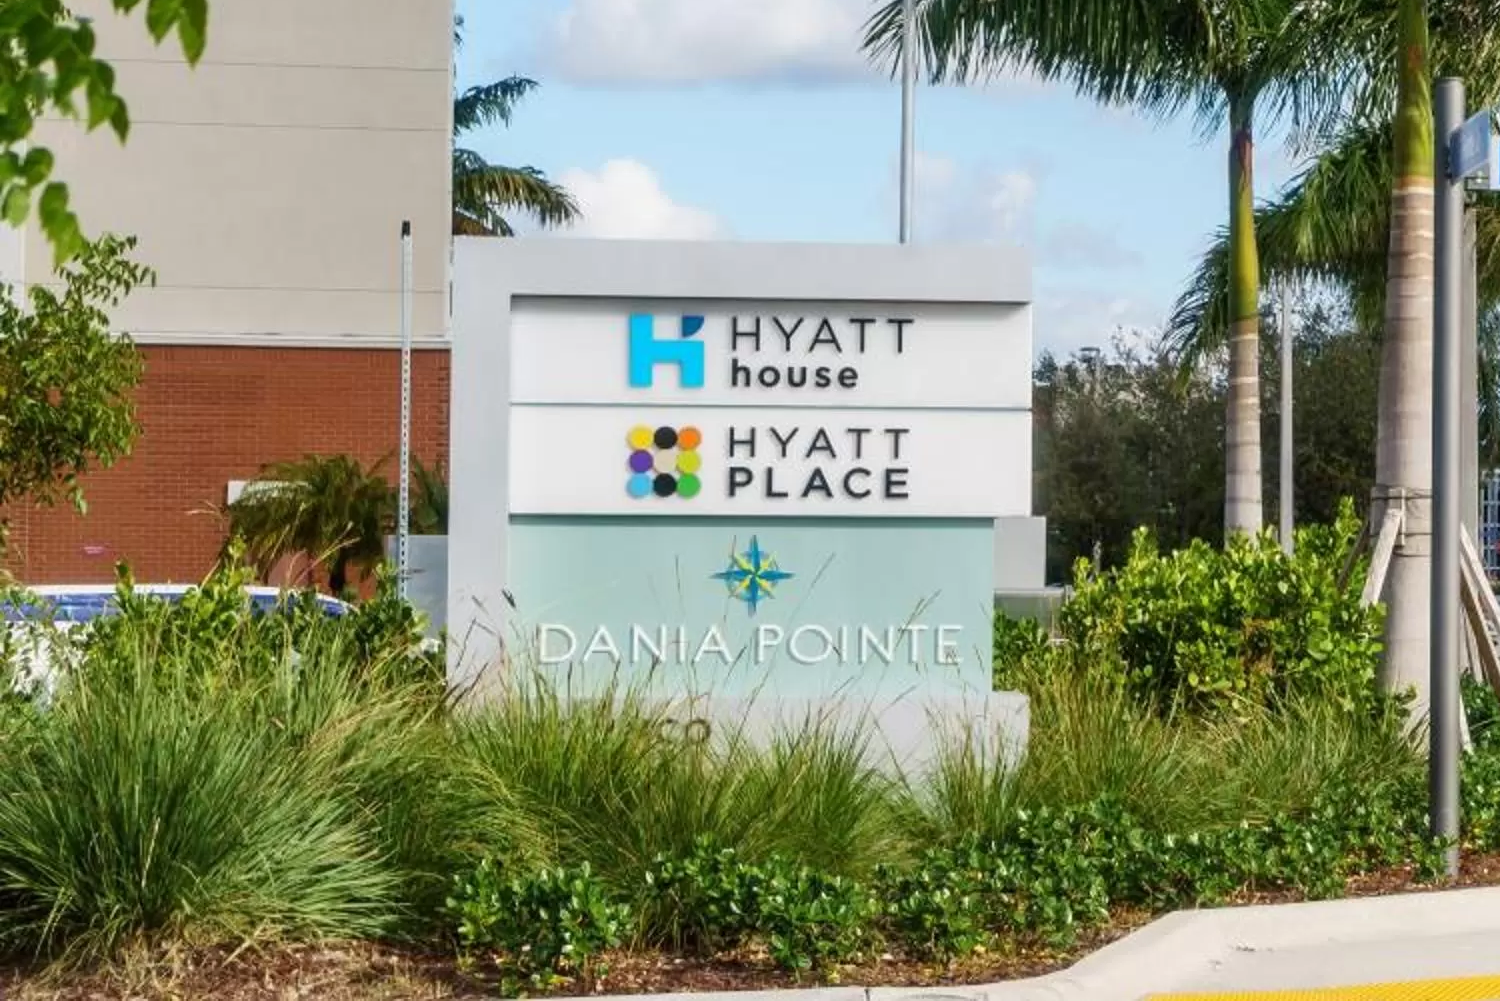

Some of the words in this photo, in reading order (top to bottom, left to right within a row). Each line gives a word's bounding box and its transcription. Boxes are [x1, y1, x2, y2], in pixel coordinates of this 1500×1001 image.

[731, 316, 915, 354] HYATT
[731, 358, 859, 388] house
[728, 426, 910, 459] HYATT
[728, 466, 909, 499] PLACE
[537, 623, 734, 665] DANIA
[753, 623, 964, 665] POINTE
